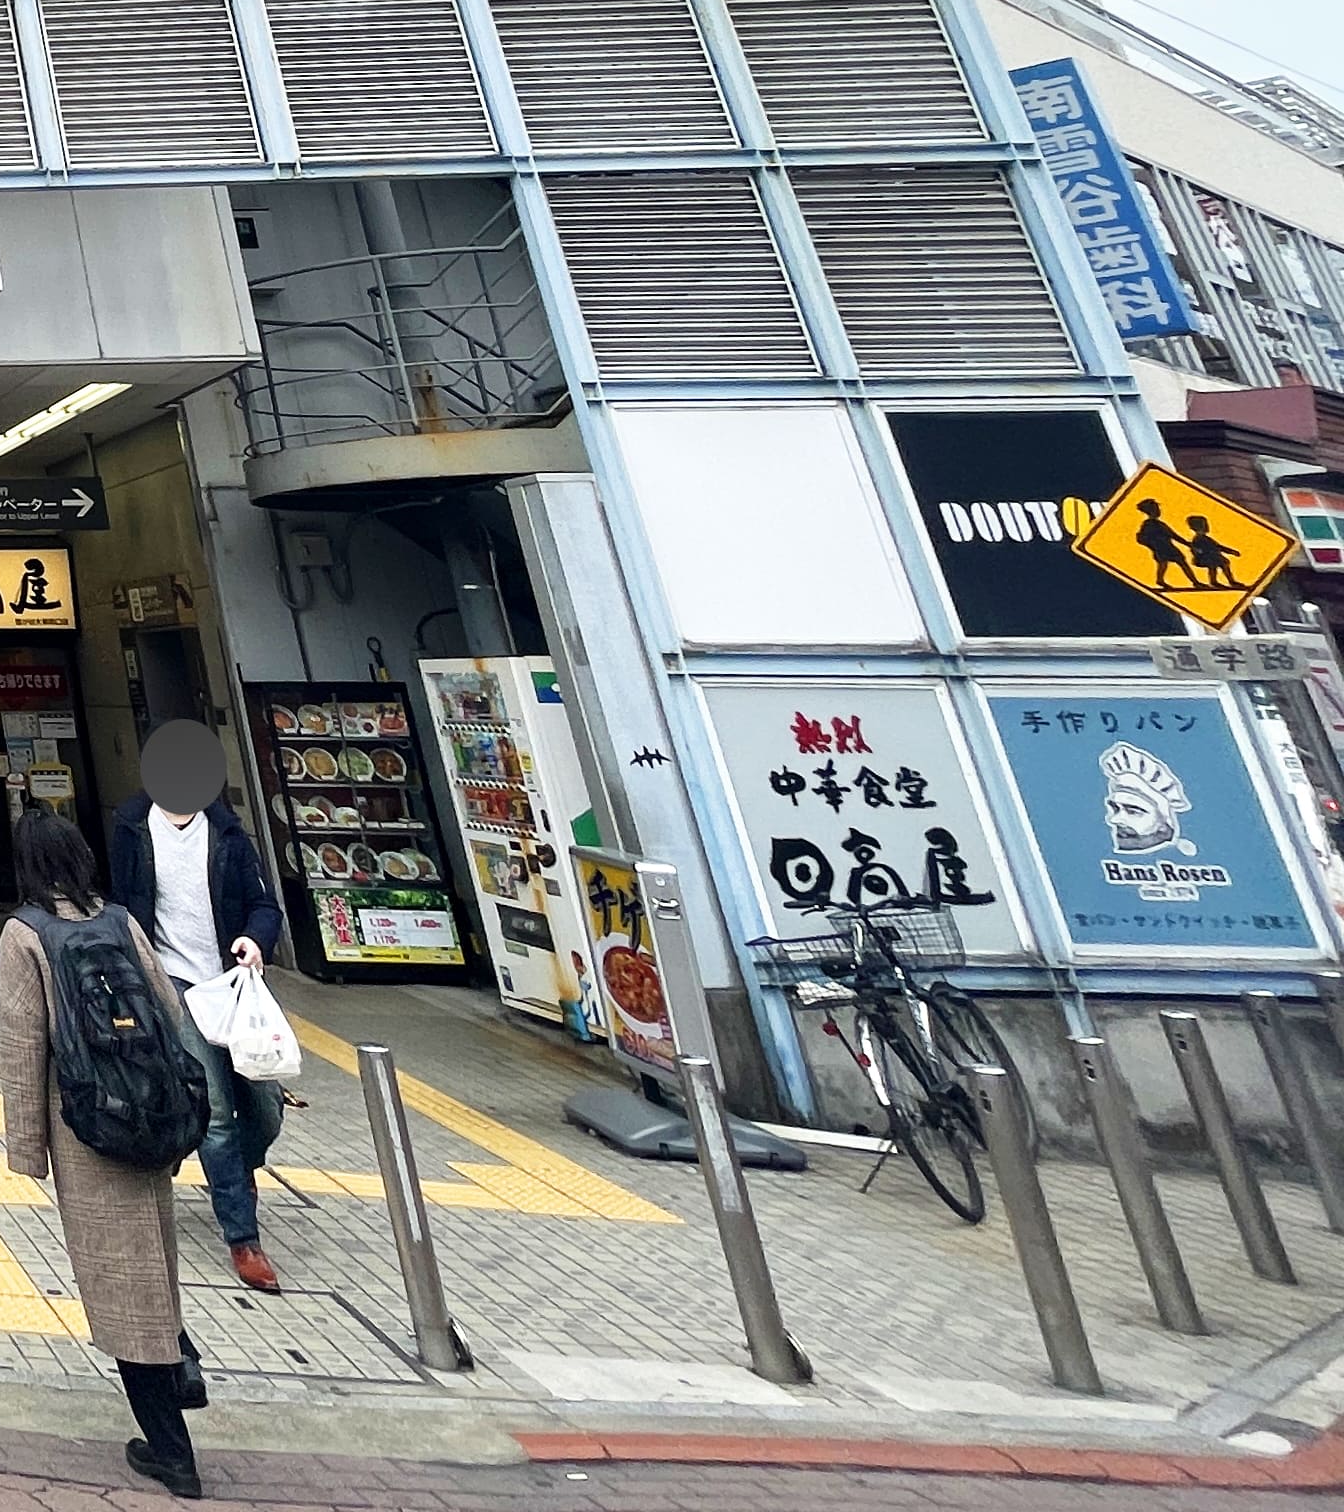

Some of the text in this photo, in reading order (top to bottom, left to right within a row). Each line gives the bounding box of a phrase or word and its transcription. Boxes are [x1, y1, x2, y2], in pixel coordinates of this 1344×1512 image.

[1016, 76, 1170, 330] 南雪谷歯科
[939, 497, 1109, 542] DOUTO
[1161, 644, 1296, 672] 通学路
[790, 711, 873, 754] 熱烈
[1021, 710, 1197, 733] 手作りパン
[768, 758, 937, 813] 中華食堂
[770, 827, 996, 906] 日高屋
[1105, 863, 1227, 882] Hans Rosen
[588, 869, 644, 952] チゲ
